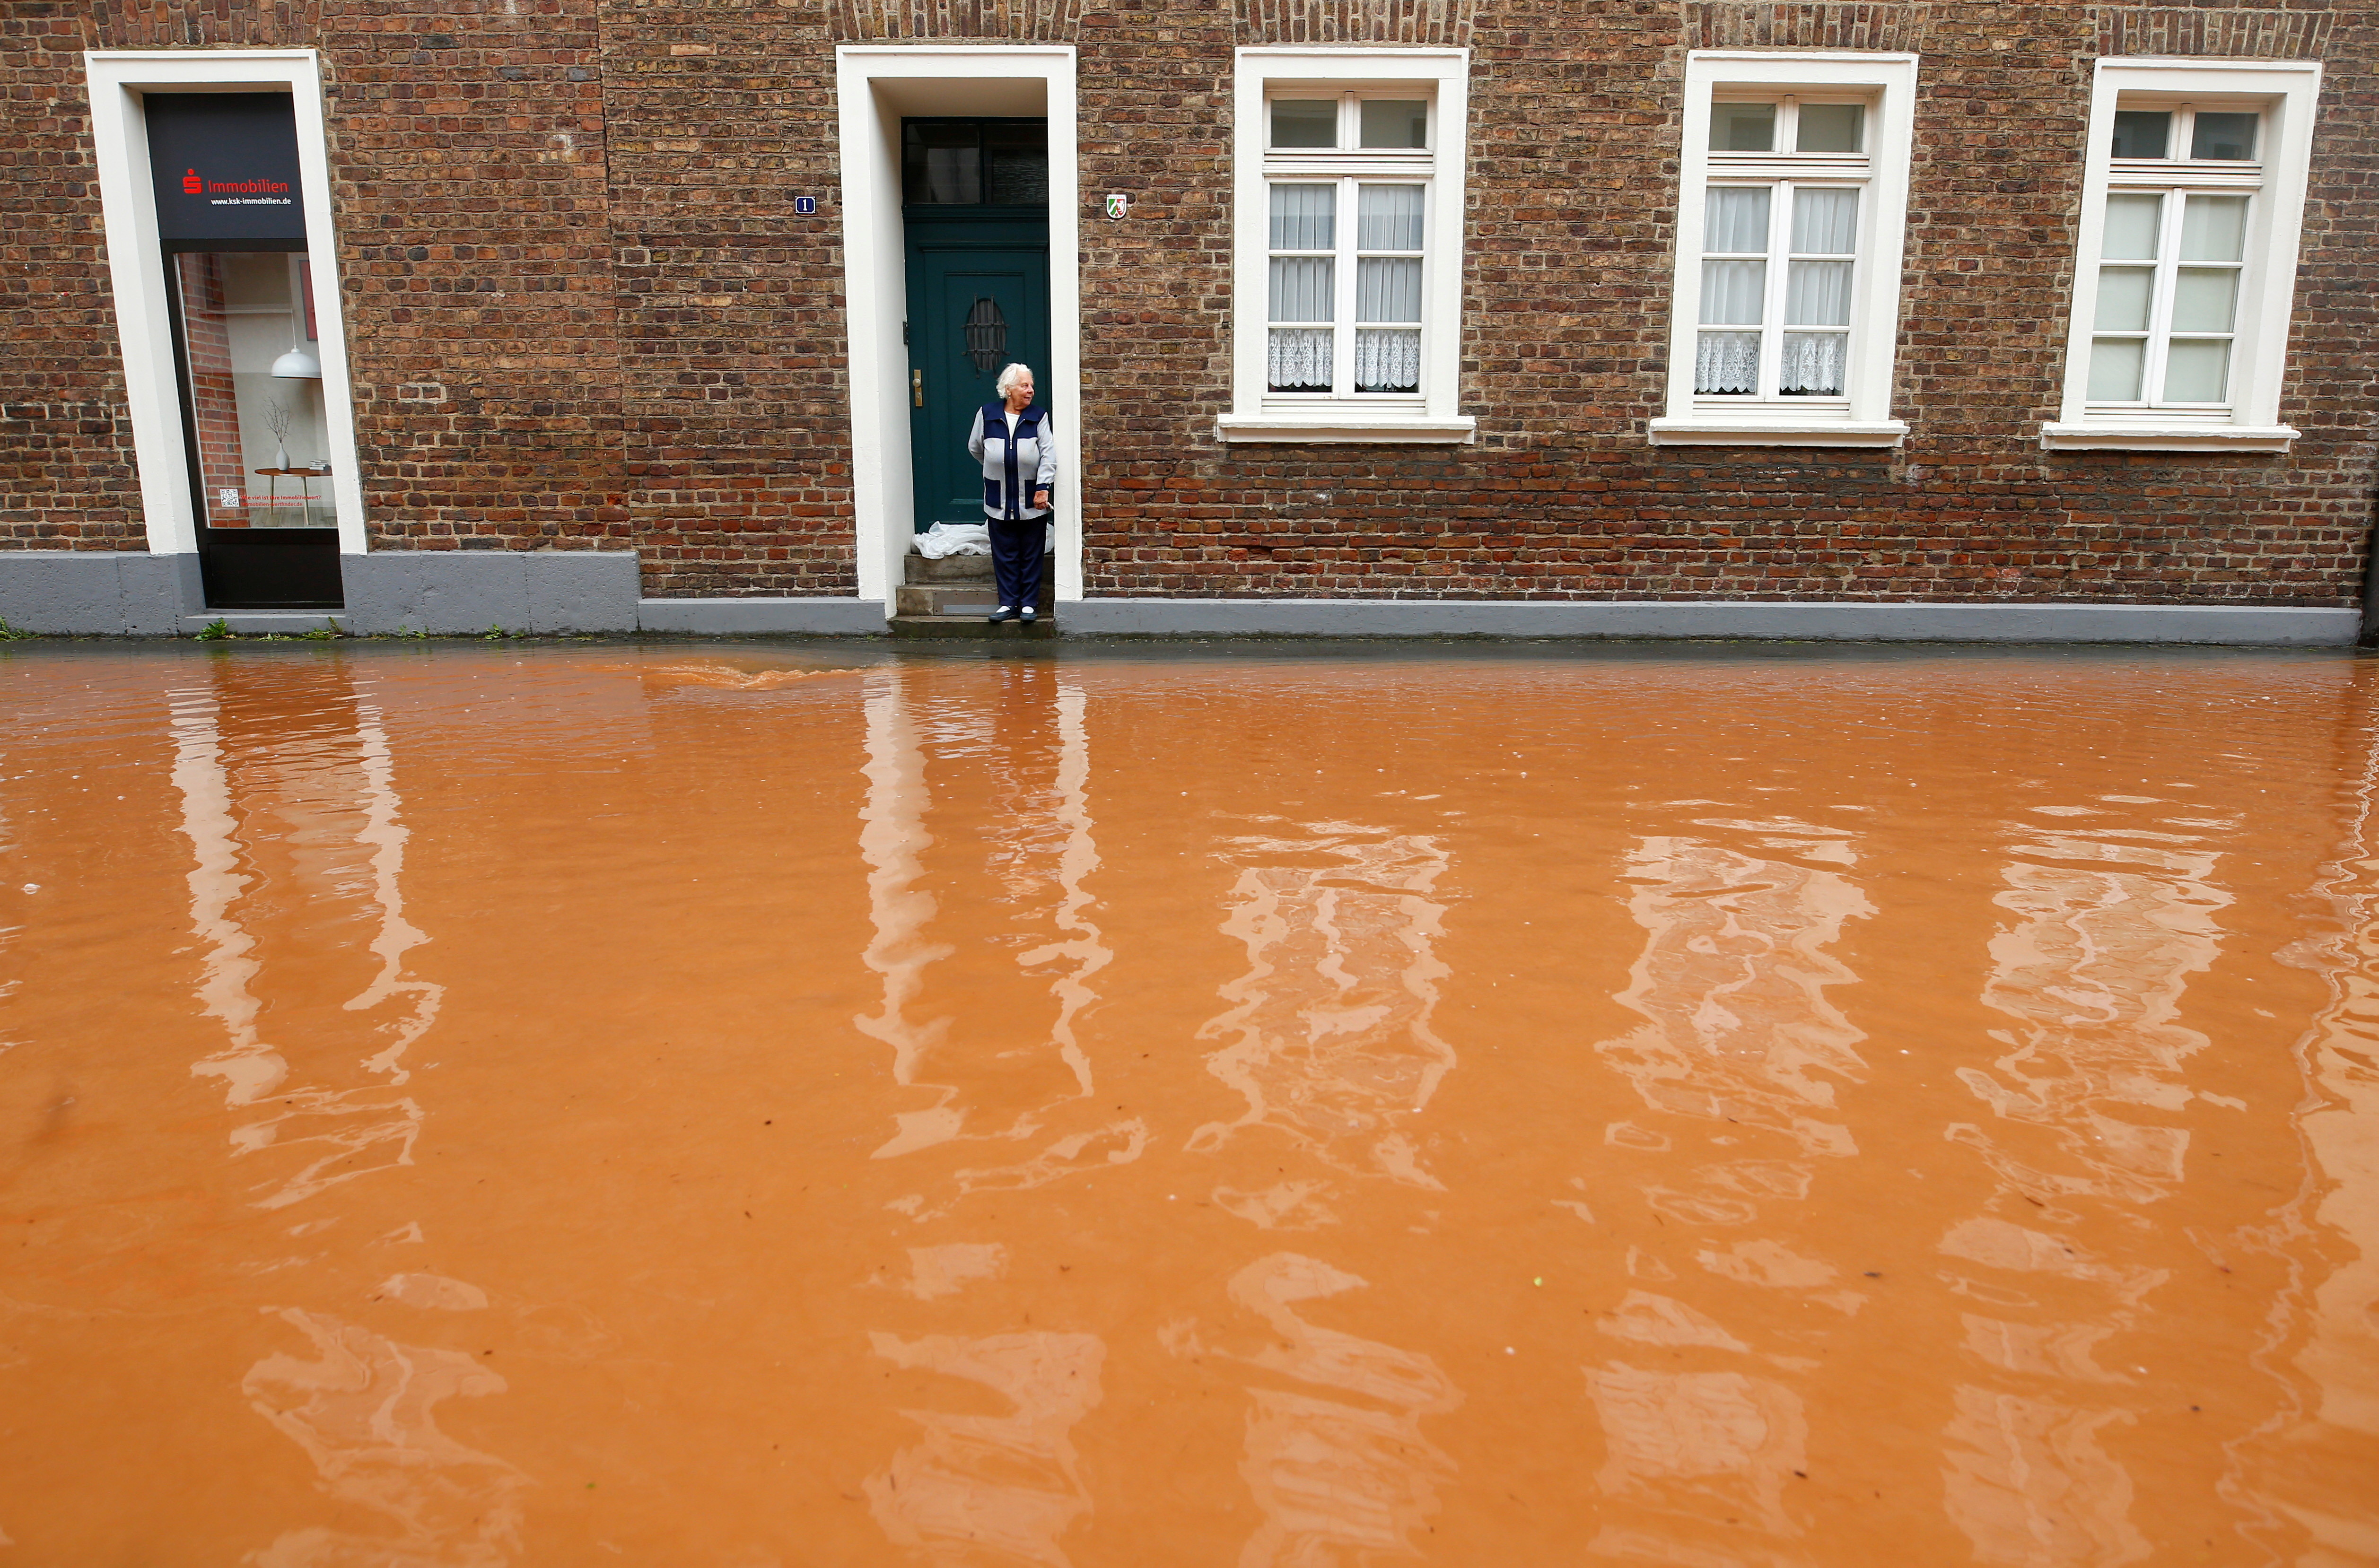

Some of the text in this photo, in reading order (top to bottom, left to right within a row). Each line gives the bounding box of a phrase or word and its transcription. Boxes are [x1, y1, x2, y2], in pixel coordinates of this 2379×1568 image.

[208, 179, 288, 193] Immobilien
[211, 197, 291, 205] www.ksk-immobilien.de
[803, 199, 808, 211] 1
